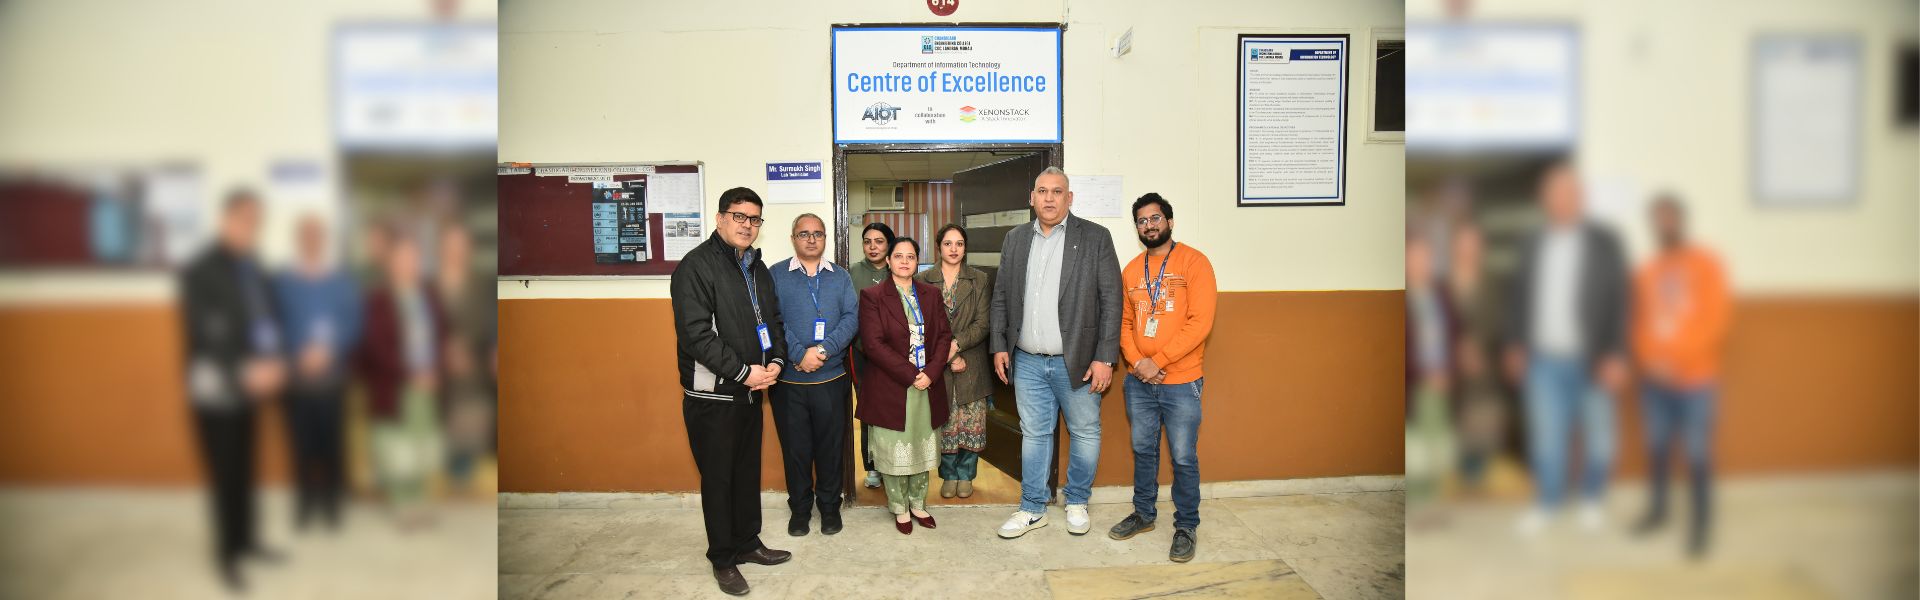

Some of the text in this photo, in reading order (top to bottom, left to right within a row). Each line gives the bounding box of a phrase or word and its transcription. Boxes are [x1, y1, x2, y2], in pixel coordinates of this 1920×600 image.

[892, 61, 927, 69] Department
[968, 61, 1001, 69] Technology
[847, 71, 1046, 93] Centre of Excellence
[978, 108, 1030, 116] XENONSTACK
